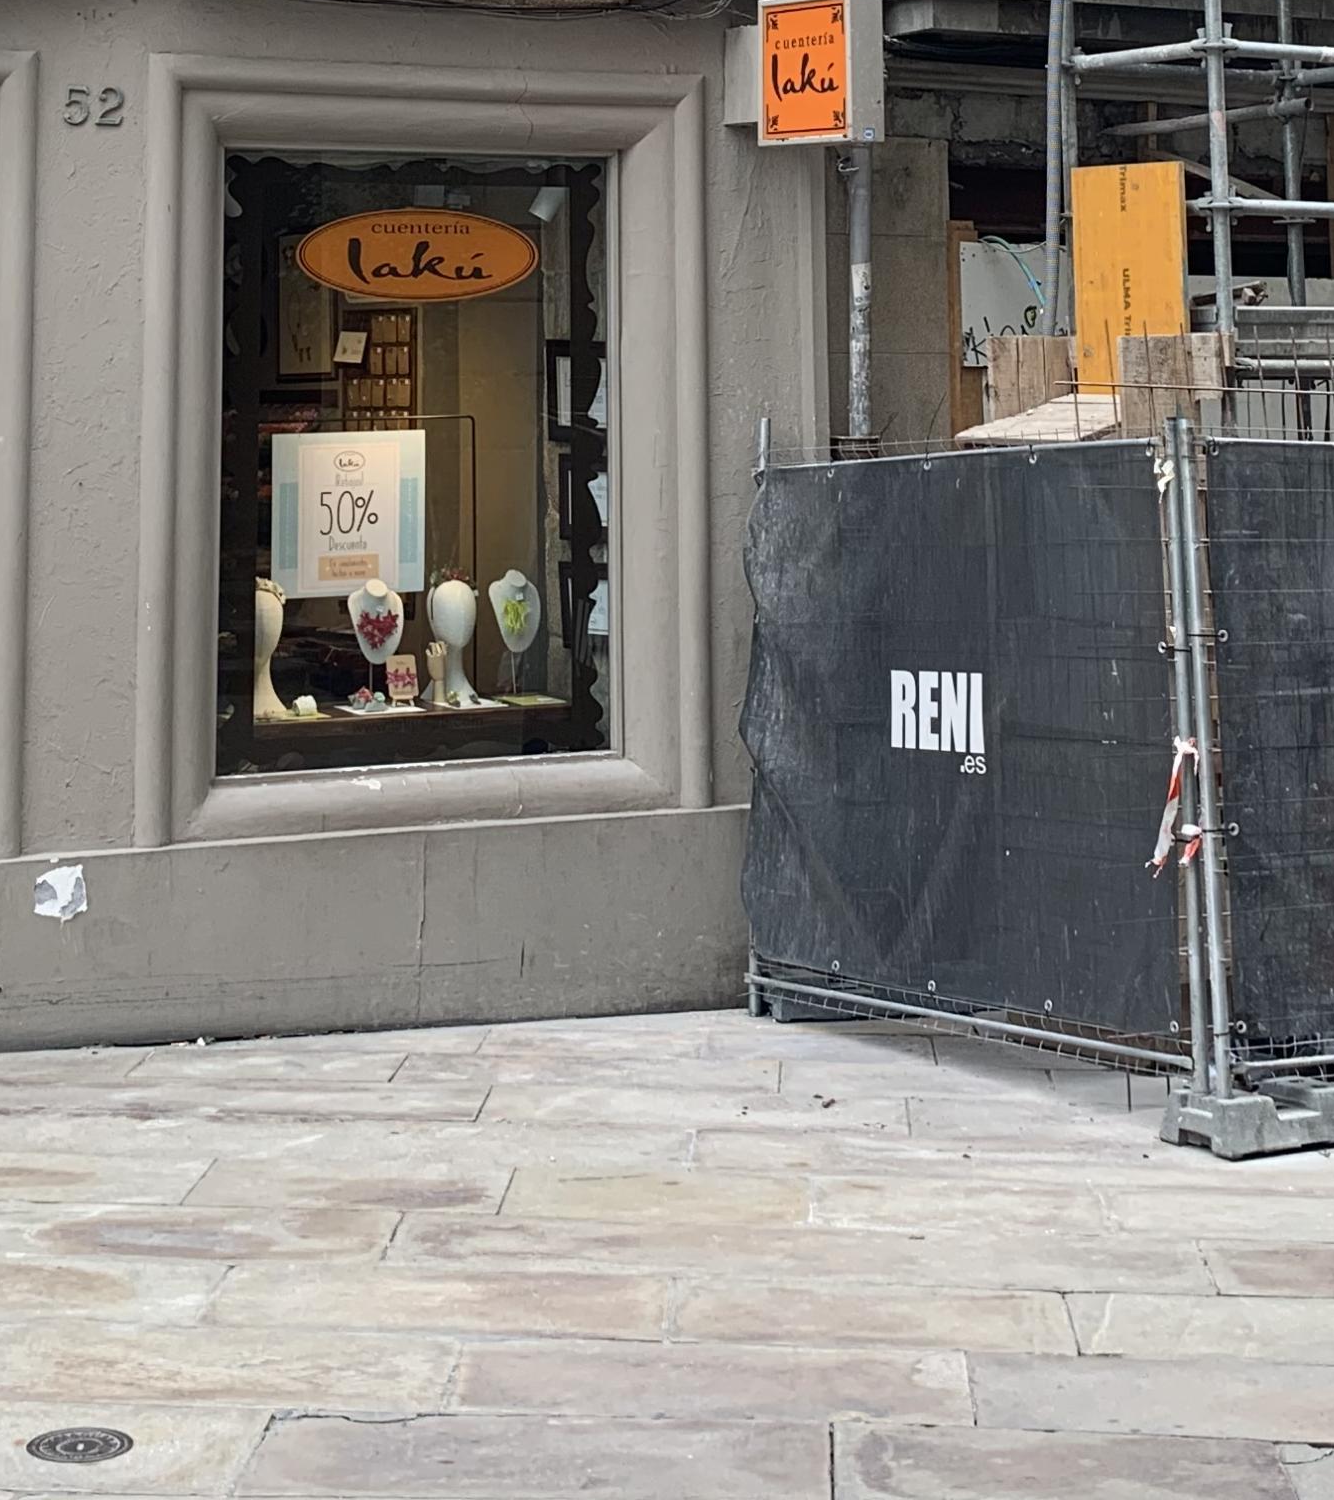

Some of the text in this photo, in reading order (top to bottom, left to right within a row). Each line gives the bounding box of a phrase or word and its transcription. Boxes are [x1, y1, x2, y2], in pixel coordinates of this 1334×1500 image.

[775, 31, 835, 50] cuentería
[771, 52, 839, 103] lakú
[64, 84, 125, 127] 52
[371, 221, 470, 235] cuentería
[347, 237, 494, 285] lakú
[1122, 268, 1131, 311] ULMA
[319, 489, 379, 535] 50%
[890, 669, 985, 754] RENI
[959, 754, 987, 774] .es
